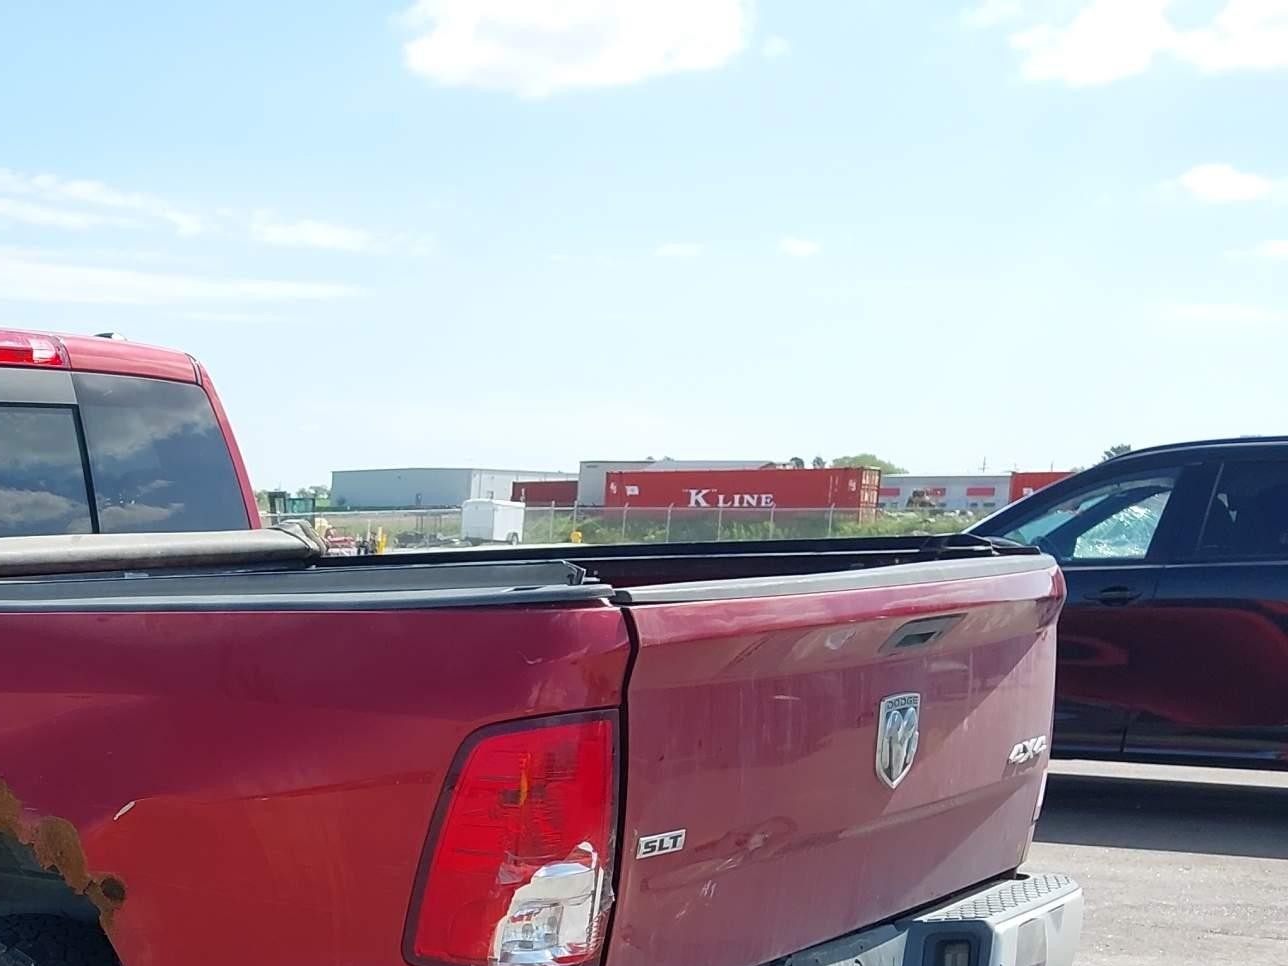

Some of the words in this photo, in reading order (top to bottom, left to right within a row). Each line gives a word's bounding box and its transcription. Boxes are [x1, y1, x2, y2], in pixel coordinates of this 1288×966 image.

[717, 494, 774, 507] LINE
[886, 696, 919, 709] DODGE
[642, 834, 683, 855] SLT
